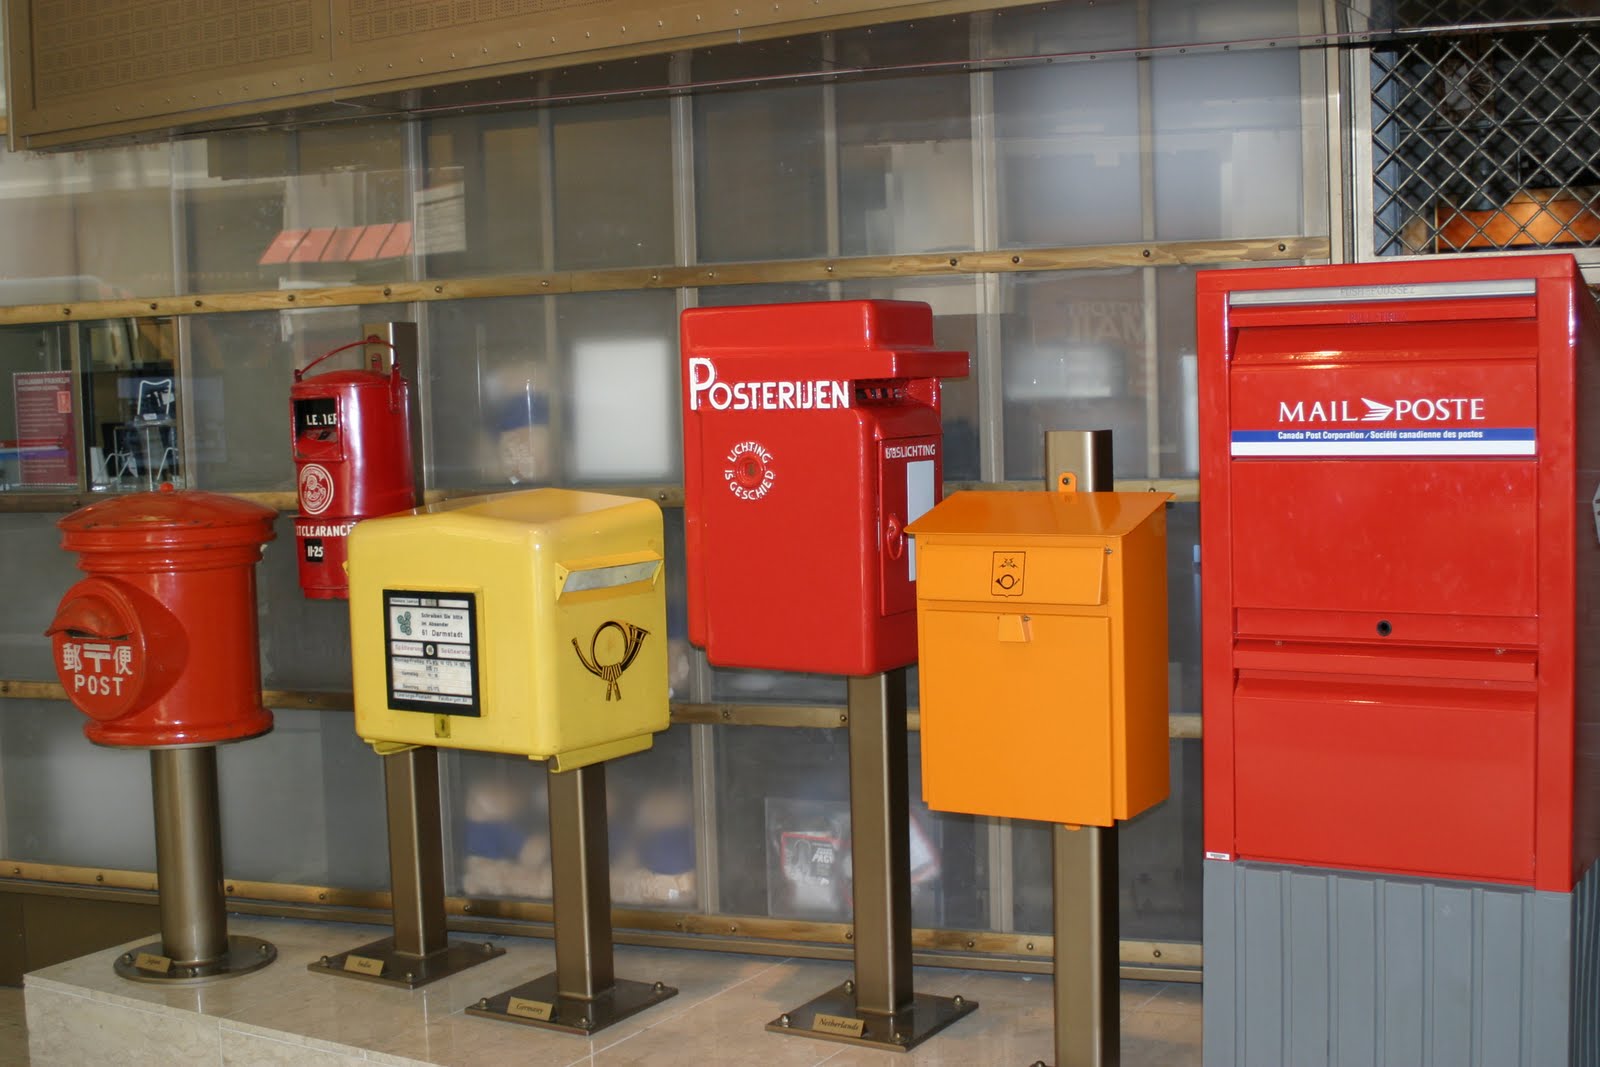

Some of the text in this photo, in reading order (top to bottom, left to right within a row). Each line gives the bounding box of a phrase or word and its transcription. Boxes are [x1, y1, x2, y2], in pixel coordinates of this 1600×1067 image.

[689, 357, 849, 410] POSTERIJEN
[1278, 398, 1485, 422] MAIL POSTE
[1278, 432, 1304, 440] Canada
[1306, 431, 1322, 440] Post
[1322, 431, 1364, 440] Corporation
[1370, 430, 1397, 439] Société
[1398, 430, 1441, 439] canadienne
[1443, 430, 1456, 438] des
[1458, 430, 1483, 440] postes
[727, 441, 773, 464] LICHTING
[730, 470, 774, 500] GESCHIED
[432, 630, 463, 638] Darmstadt
[74, 674, 124, 696] POST
[819, 1018, 858, 1030] Netherlands
